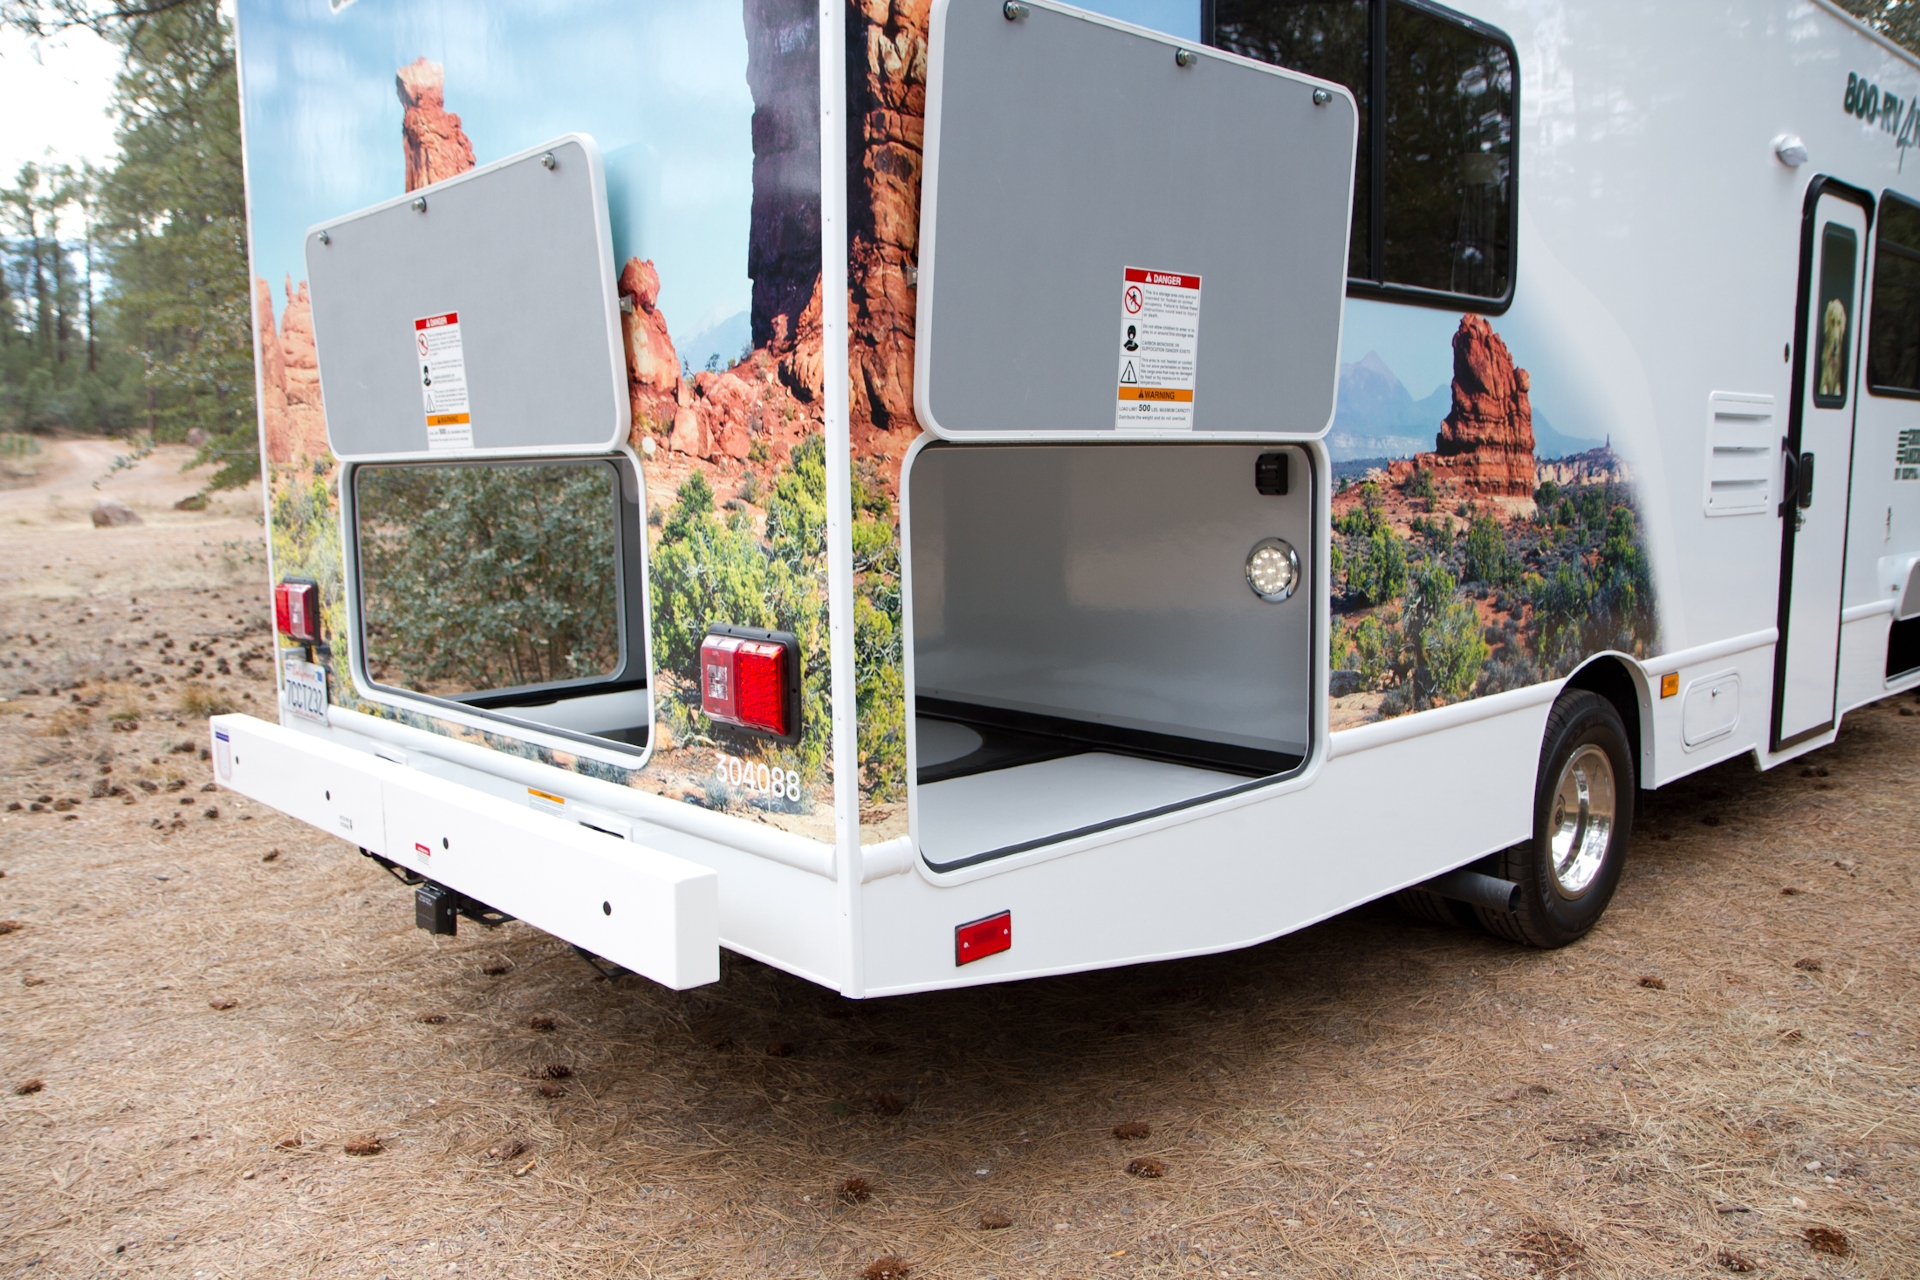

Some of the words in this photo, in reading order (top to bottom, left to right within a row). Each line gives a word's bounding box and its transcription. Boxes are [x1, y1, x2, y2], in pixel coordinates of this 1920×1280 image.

[1154, 274, 1182, 286] DANGER
[1144, 390, 1175, 400] WARNING
[716, 754, 800, 802] 304088
